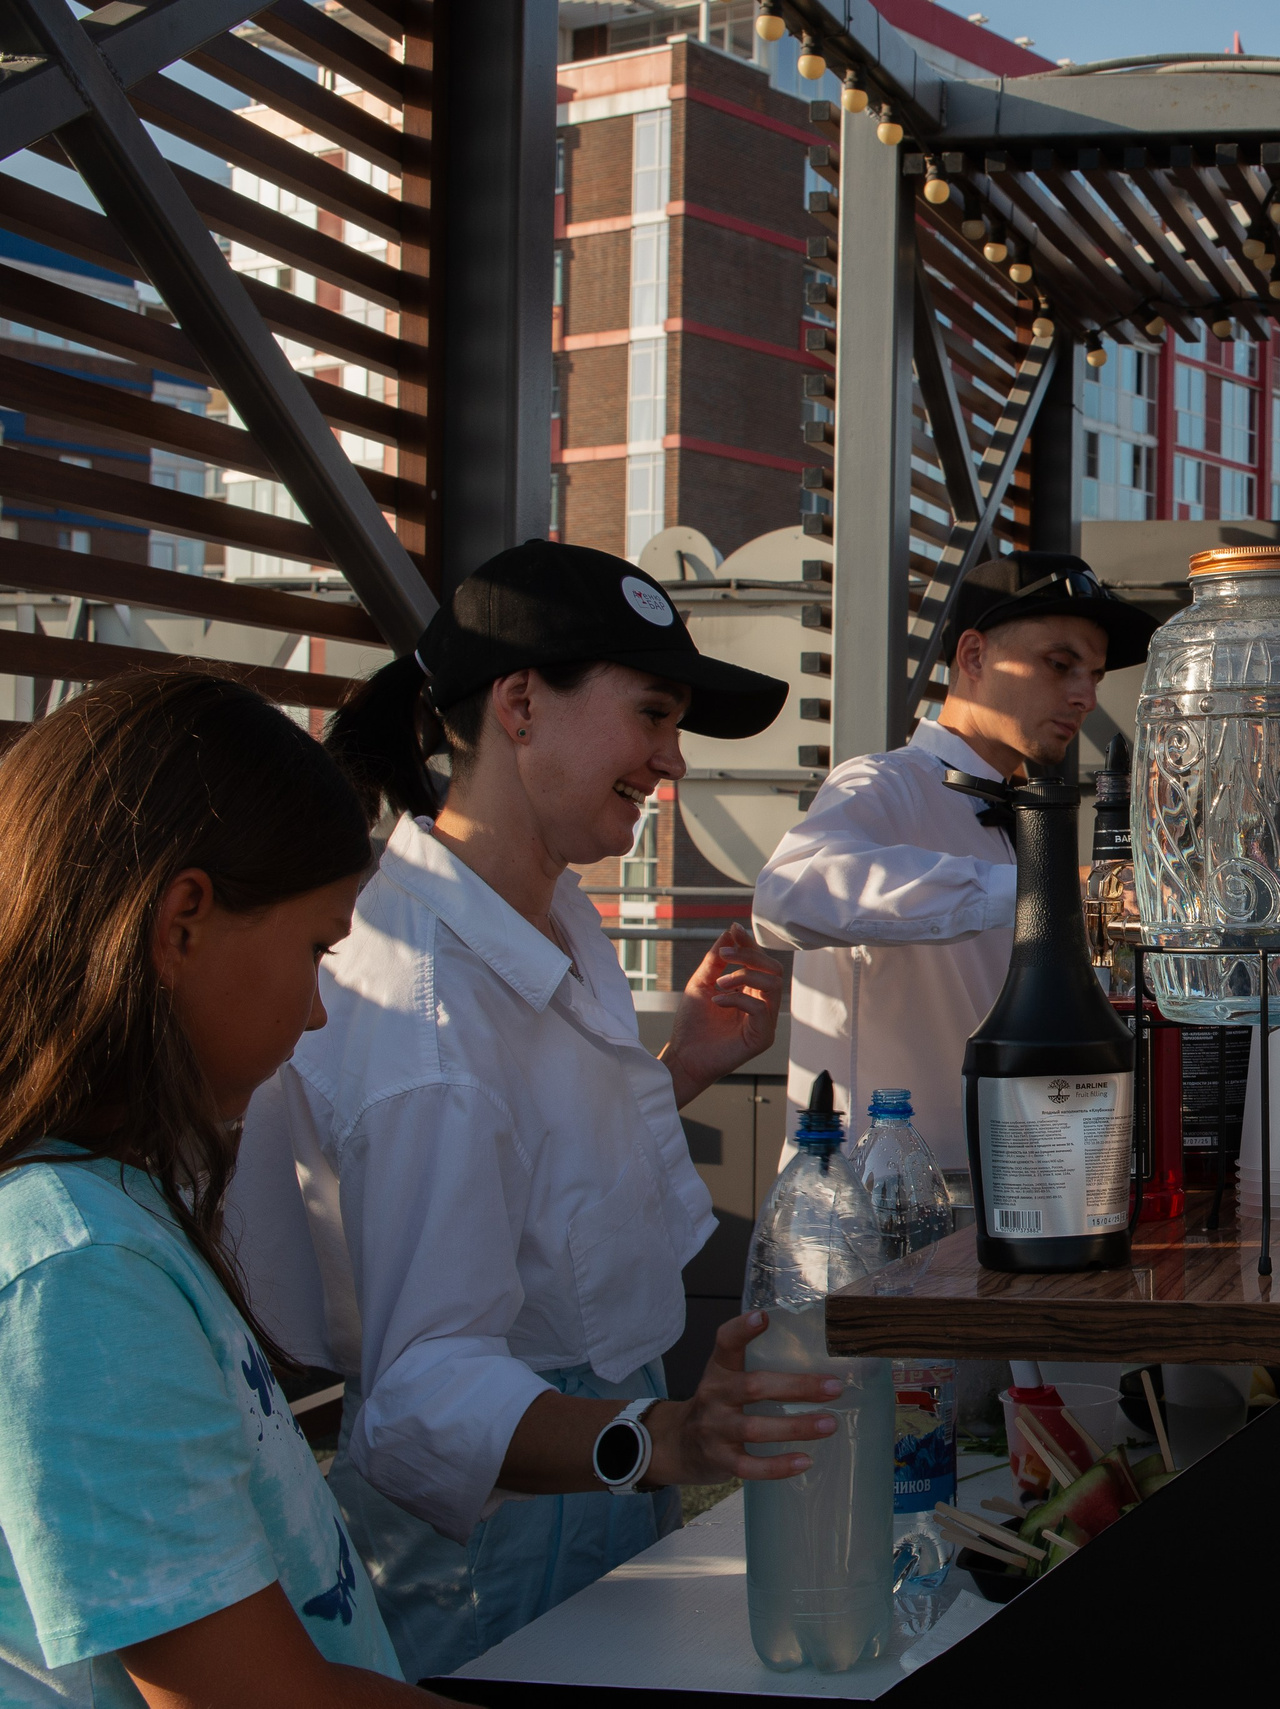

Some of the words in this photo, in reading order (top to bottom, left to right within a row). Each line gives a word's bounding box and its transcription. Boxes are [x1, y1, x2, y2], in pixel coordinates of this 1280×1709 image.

[647, 600, 665, 611] БАР
[1075, 1081, 1108, 1090] BARLINE
[1090, 1090, 1108, 1099] filling
[1092, 1215, 1120, 1226] 15/04/25
[894, 1478, 931, 1494] НИКОВ
